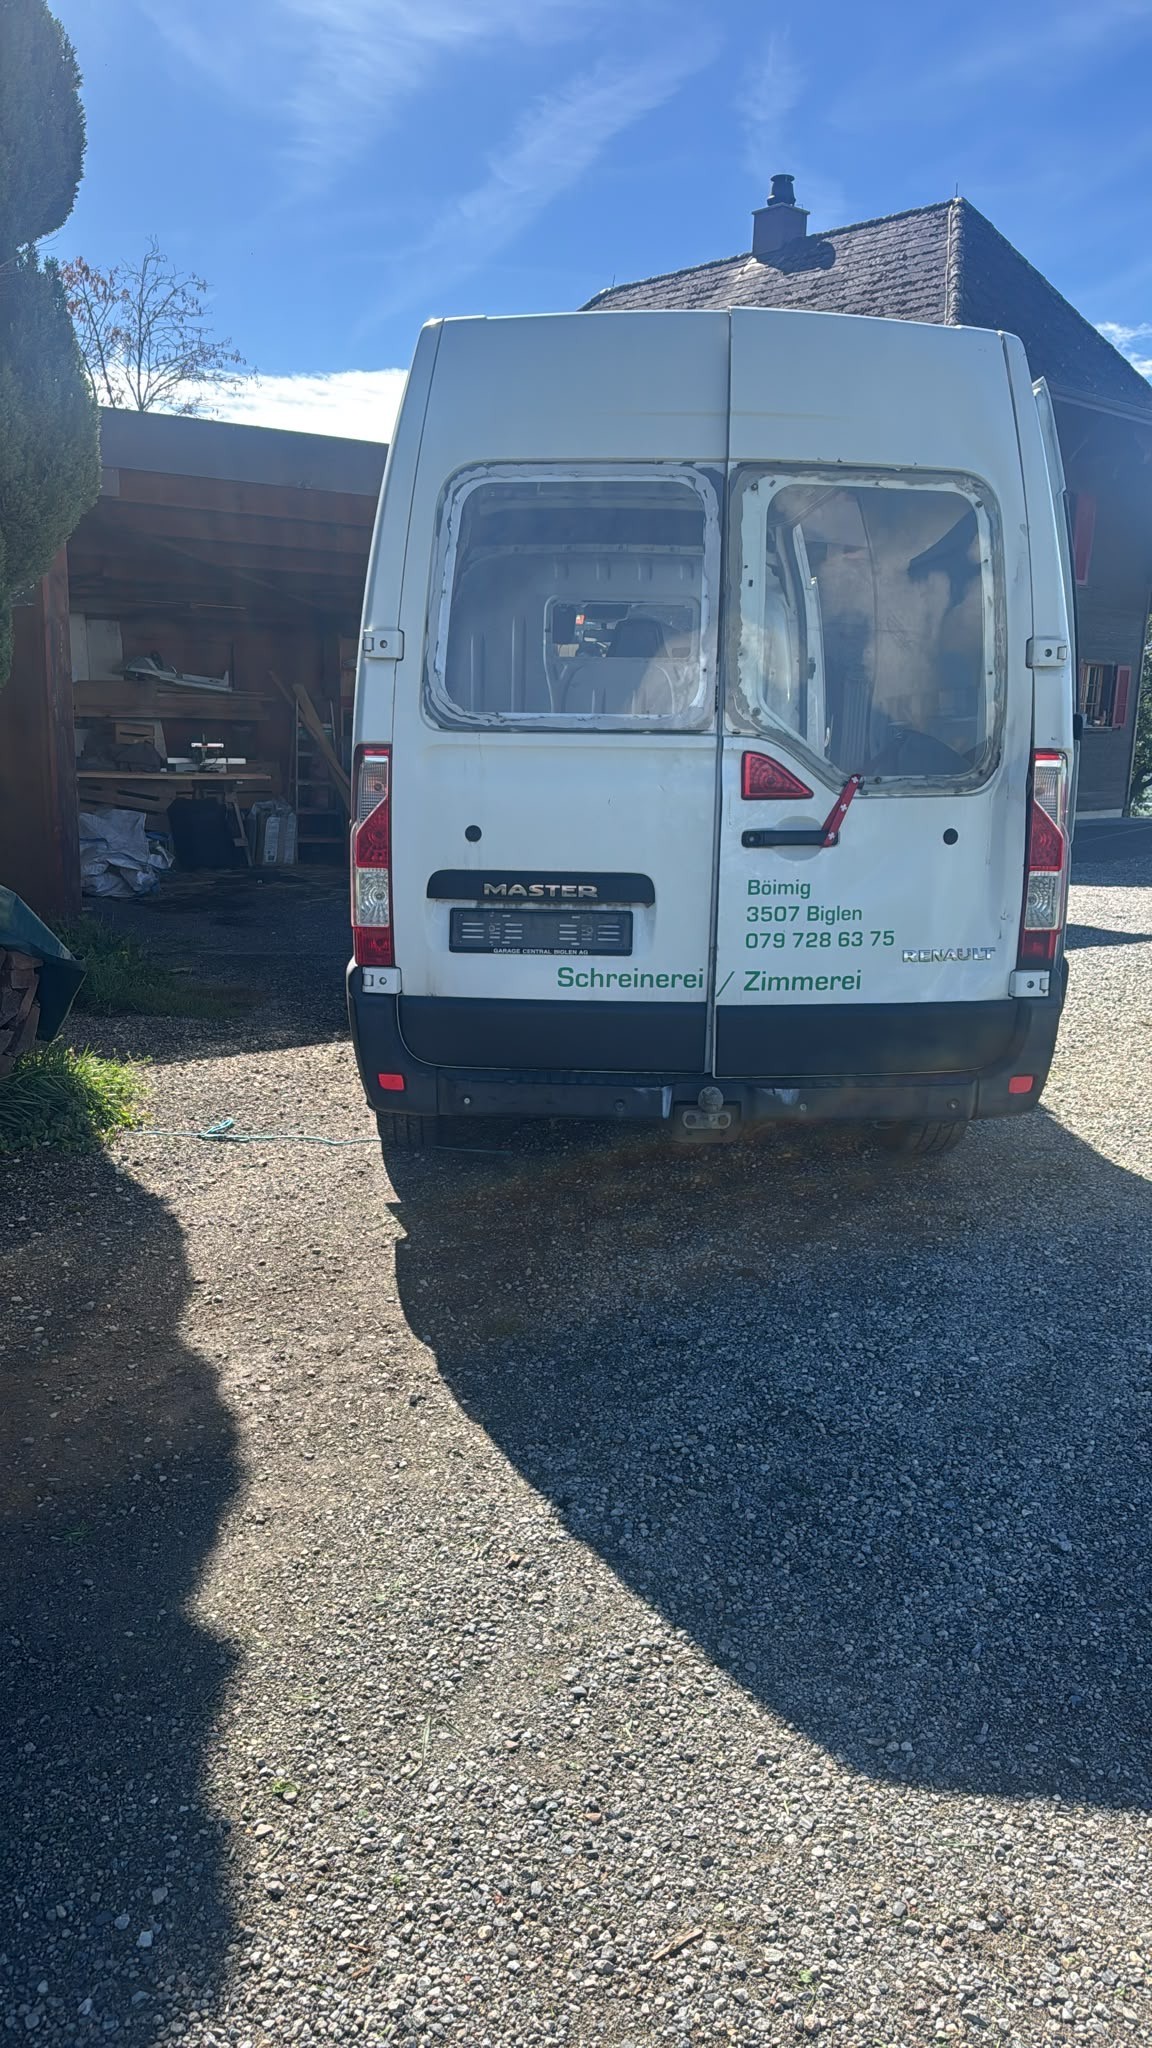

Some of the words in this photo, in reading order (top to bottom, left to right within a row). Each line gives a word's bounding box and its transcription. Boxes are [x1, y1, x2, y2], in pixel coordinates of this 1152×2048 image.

[484, 883, 598, 898] MASTER
[747, 879, 811, 899] Böimig
[746, 906, 800, 922] 3507
[807, 905, 862, 925] Biglen
[745, 932, 786, 949] 079
[792, 932, 832, 948] 728
[838, 931, 863, 947] 63
[870, 930, 895, 947] 75
[902, 948, 996, 963] RENAULT
[557, 966, 704, 989] Schreinerei
[743, 970, 862, 992] Zimmerei
